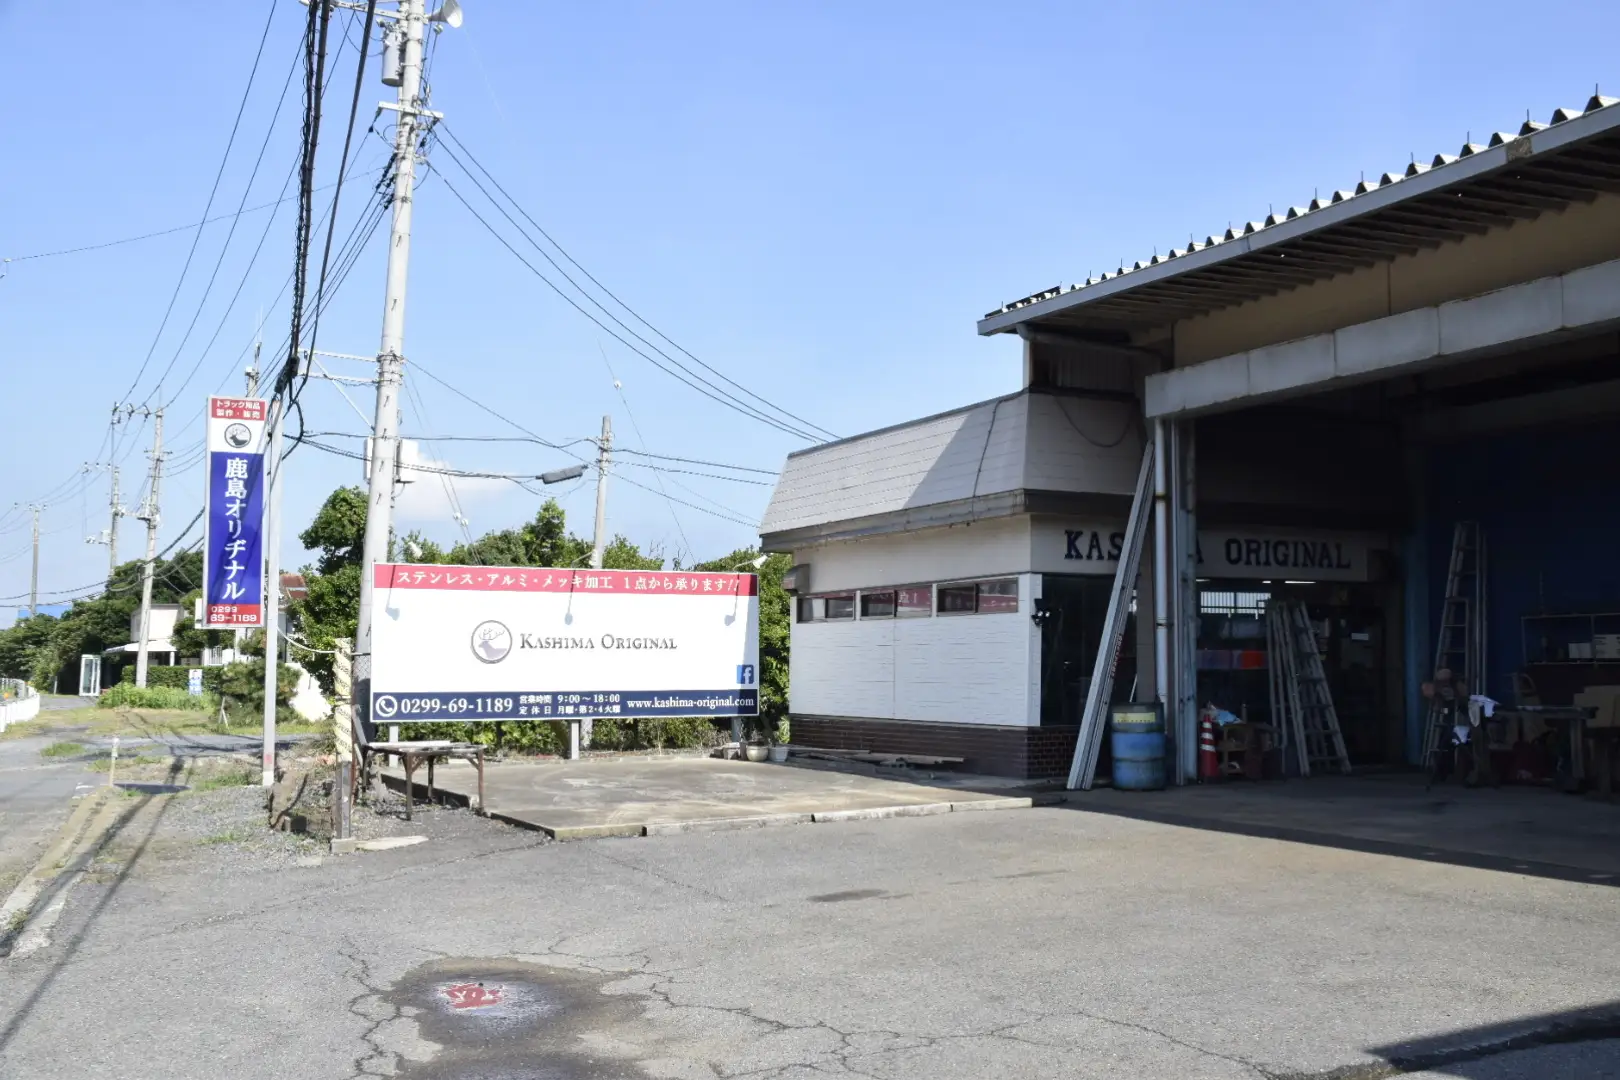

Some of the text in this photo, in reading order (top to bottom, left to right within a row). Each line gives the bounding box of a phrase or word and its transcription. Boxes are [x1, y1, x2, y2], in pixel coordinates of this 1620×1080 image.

[222, 457, 249, 600] 鹿島オリヂナル
[1224, 537, 1351, 569] ORIGINAL
[211, 605, 238, 613] 0299
[210, 614, 257, 622] 69-1189
[400, 697, 513, 714] 0299-69-1189
[626, 695, 755, 710] www.kashima-original.com
